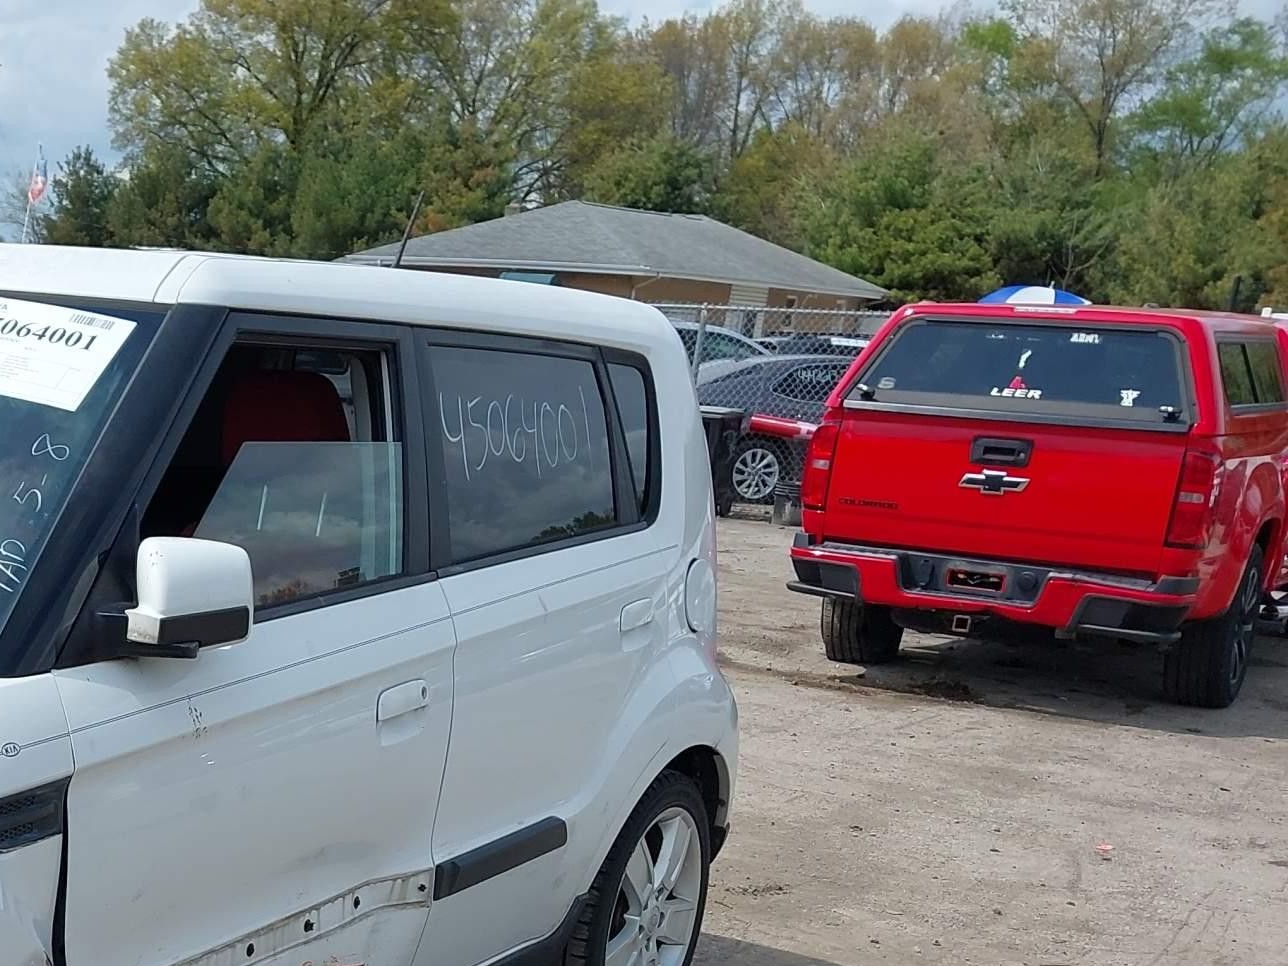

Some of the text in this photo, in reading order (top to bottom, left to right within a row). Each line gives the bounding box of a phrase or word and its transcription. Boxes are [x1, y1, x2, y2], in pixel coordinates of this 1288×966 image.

[990, 387, 1042, 399] LEER
[439, 385, 594, 481] 45064001
[3, 744, 19, 755] KIA
